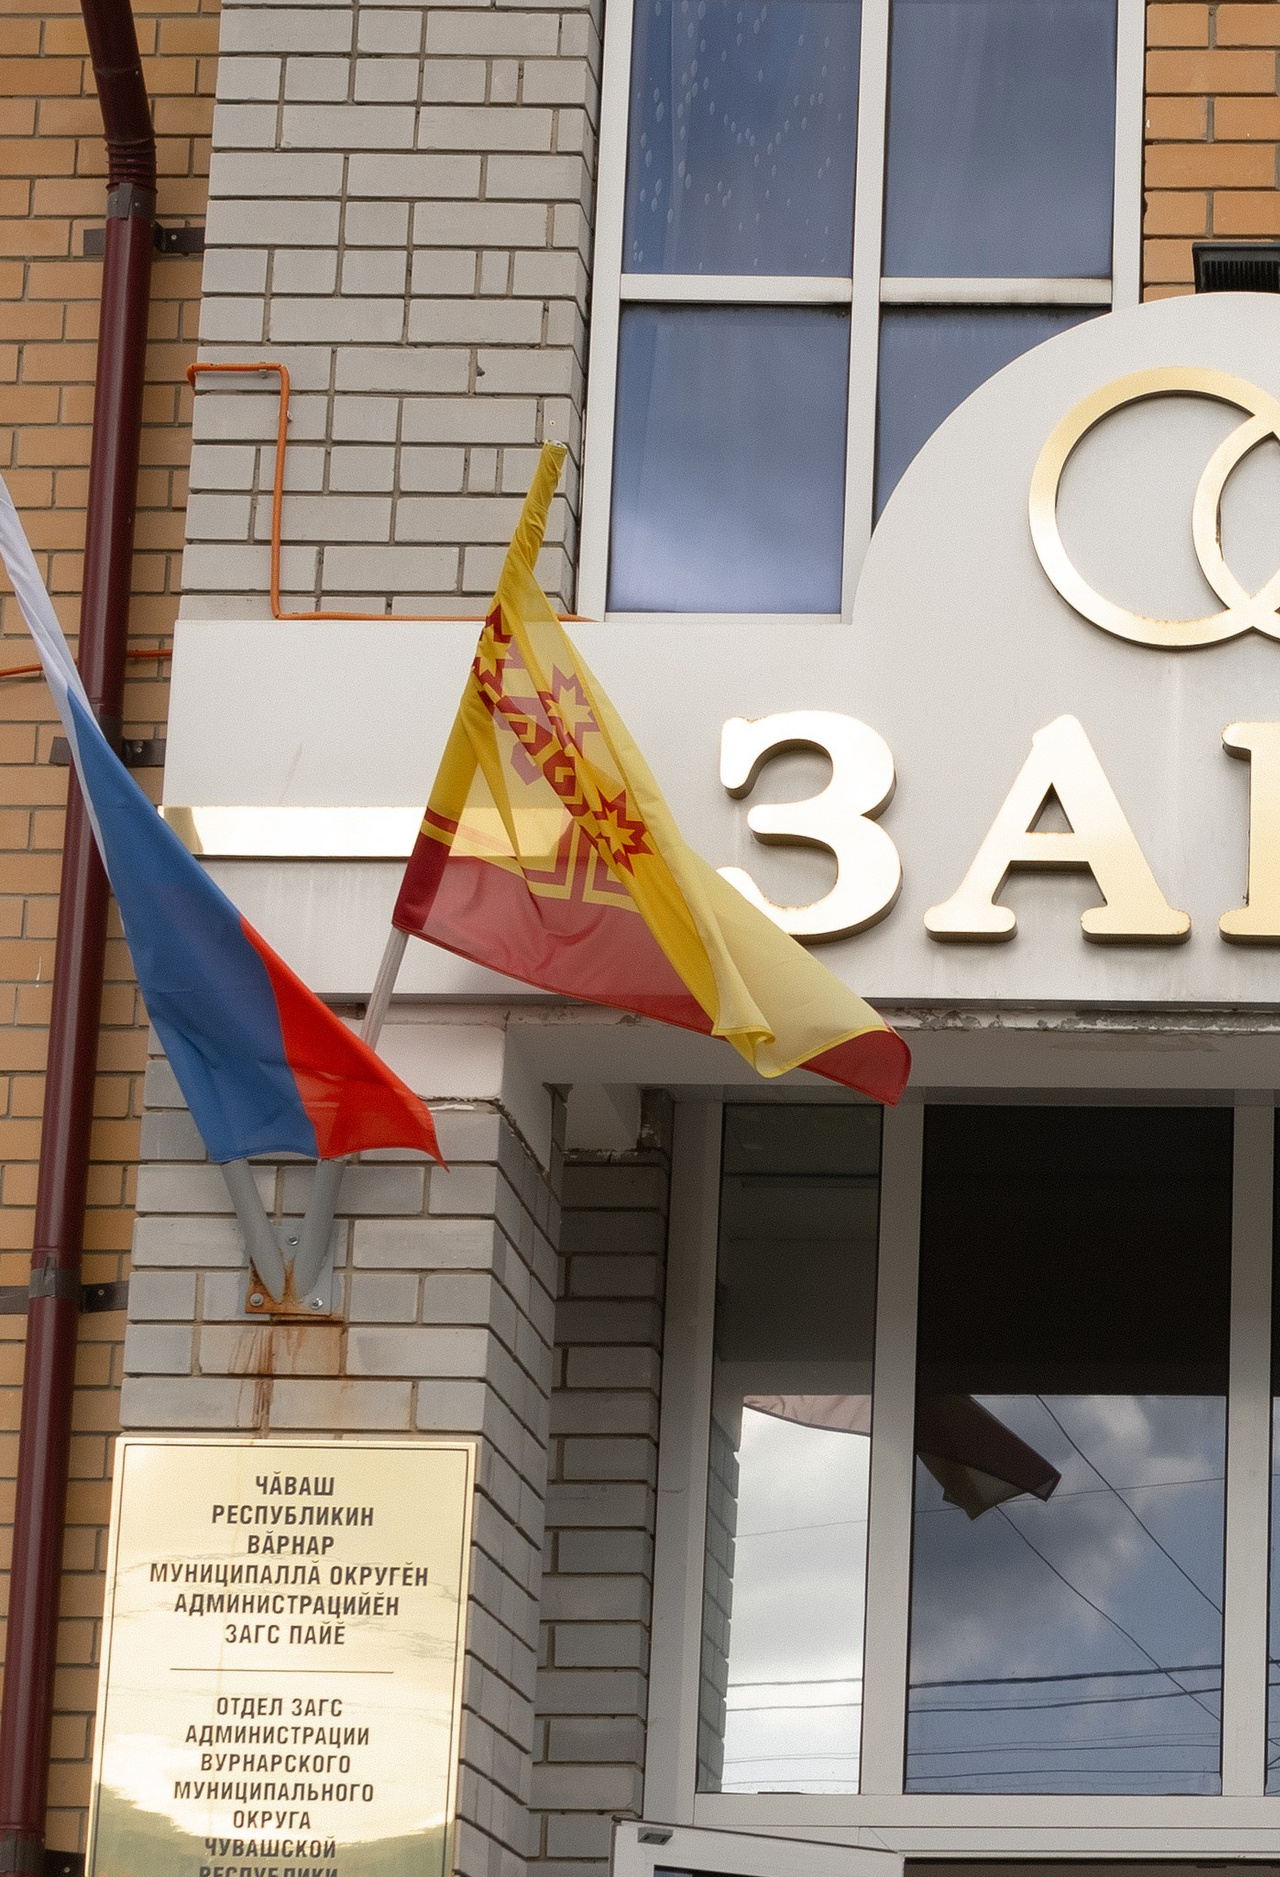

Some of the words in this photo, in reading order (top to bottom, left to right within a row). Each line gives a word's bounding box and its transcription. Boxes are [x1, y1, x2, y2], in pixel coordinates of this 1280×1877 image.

[254, 1471, 335, 1497] ЧӐВАШ
[211, 1505, 374, 1527] РЕСПУБЛИКИН
[225, 1624, 280, 1645] ЗАГС
[216, 1697, 282, 1718] ОТДЕЛ
[291, 1697, 343, 1718] ЗАГС
[185, 1725, 370, 1748] АДМИНИСТРАЦИИ
[200, 1752, 351, 1774] ВУРНАРСКОГО
[173, 1780, 374, 1805] МУНИЦИПАЛЬНОГО
[232, 1809, 311, 1830] ОКРУГА
[204, 1834, 336, 1859] ЧУВАШСКОЙ
